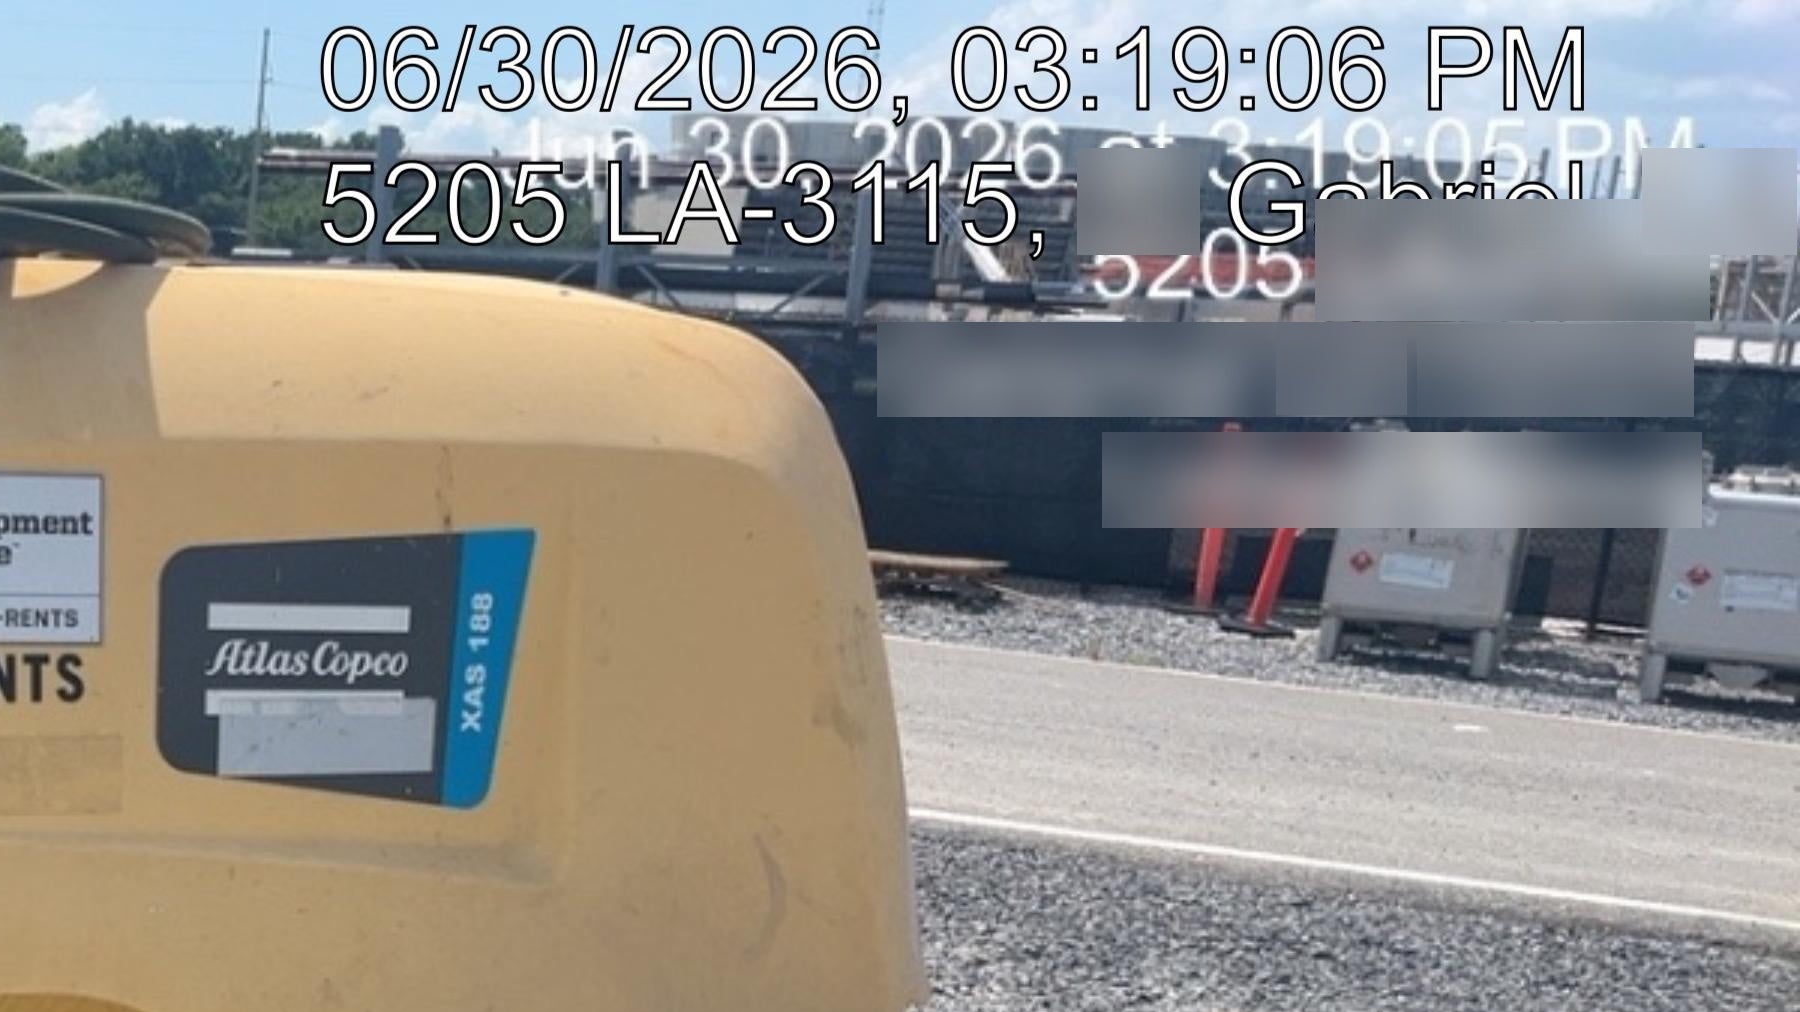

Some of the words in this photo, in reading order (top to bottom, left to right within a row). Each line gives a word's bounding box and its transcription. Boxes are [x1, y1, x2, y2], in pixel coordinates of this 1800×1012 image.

[468, 592, 494, 652] 188
[204, 638, 309, 677] Atlas
[310, 640, 409, 683] Copco
[460, 662, 488, 733] XAS
